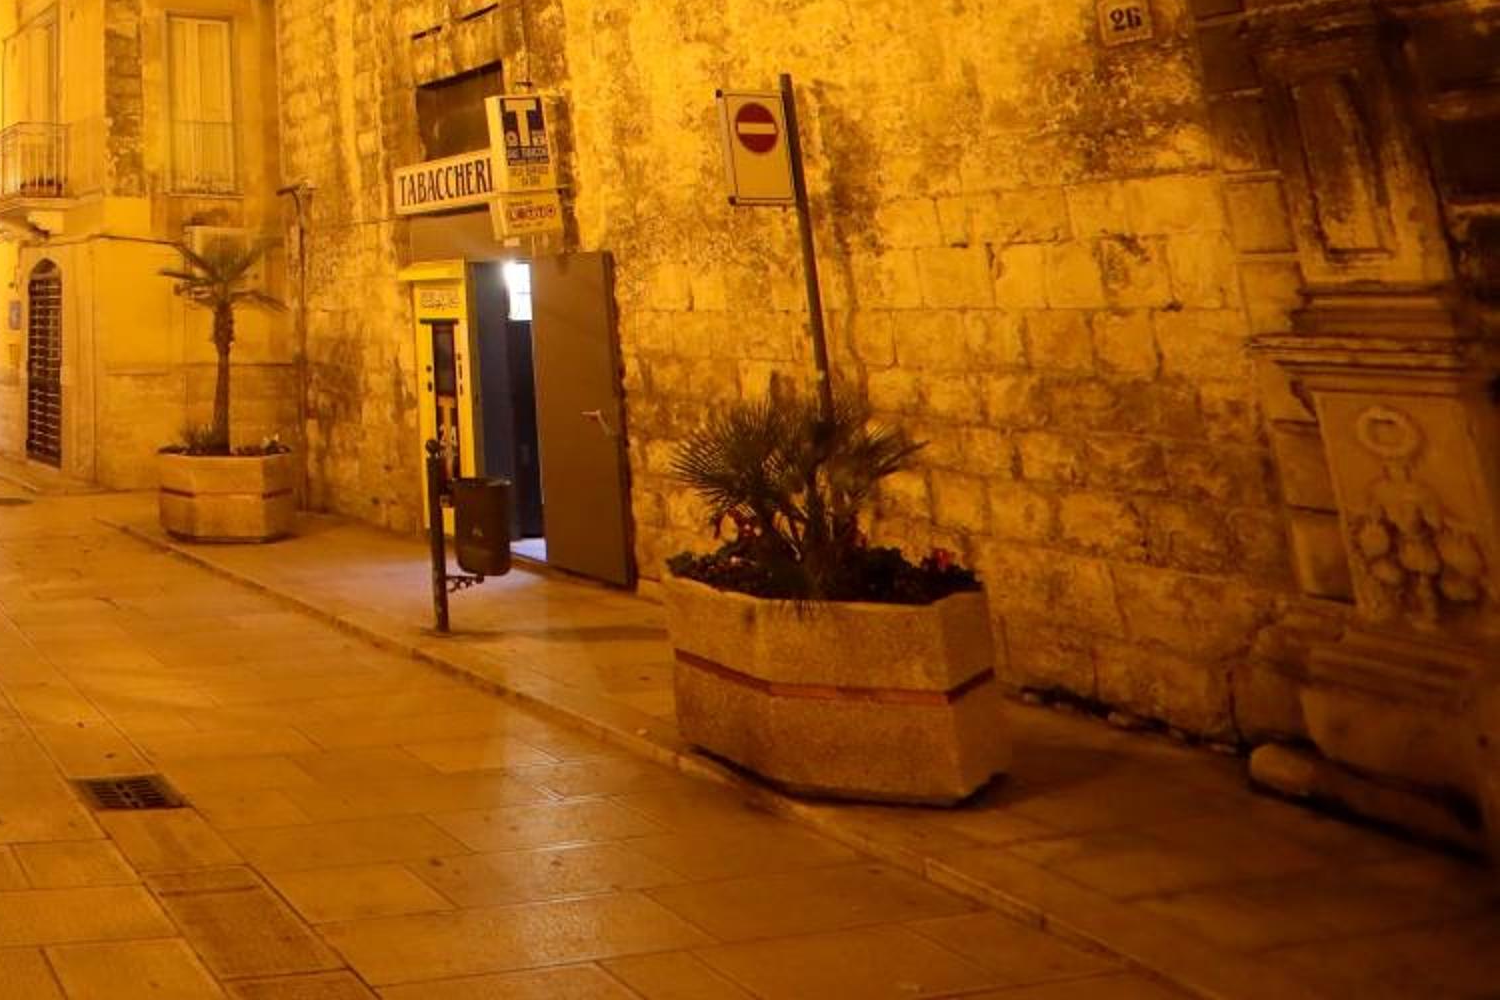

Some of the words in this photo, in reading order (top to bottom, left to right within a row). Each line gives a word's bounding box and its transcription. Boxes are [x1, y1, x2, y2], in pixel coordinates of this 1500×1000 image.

[1110, 7, 1142, 32] 26
[504, 99, 537, 147] T
[399, 158, 493, 206] TABACCHERI
